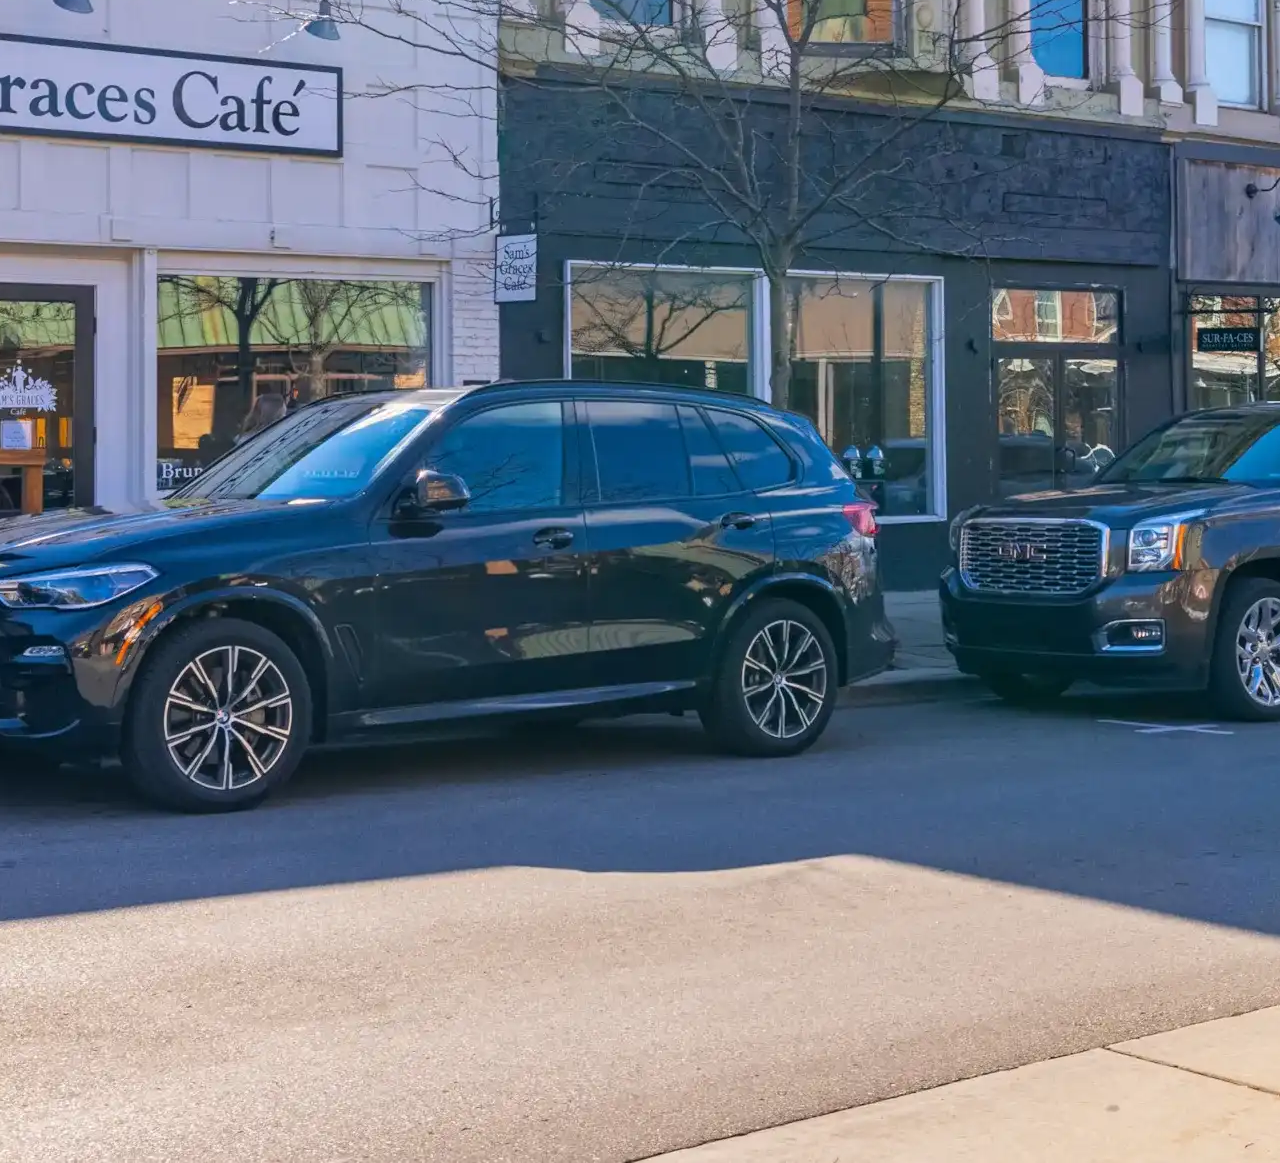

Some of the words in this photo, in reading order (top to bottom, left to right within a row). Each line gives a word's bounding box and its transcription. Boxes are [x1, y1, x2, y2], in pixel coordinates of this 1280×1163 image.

[172, 70, 307, 137] Café
[503, 245, 530, 260] Sam's
[500, 261, 534, 275] Graces
[998, 542, 1047, 561] GMC
